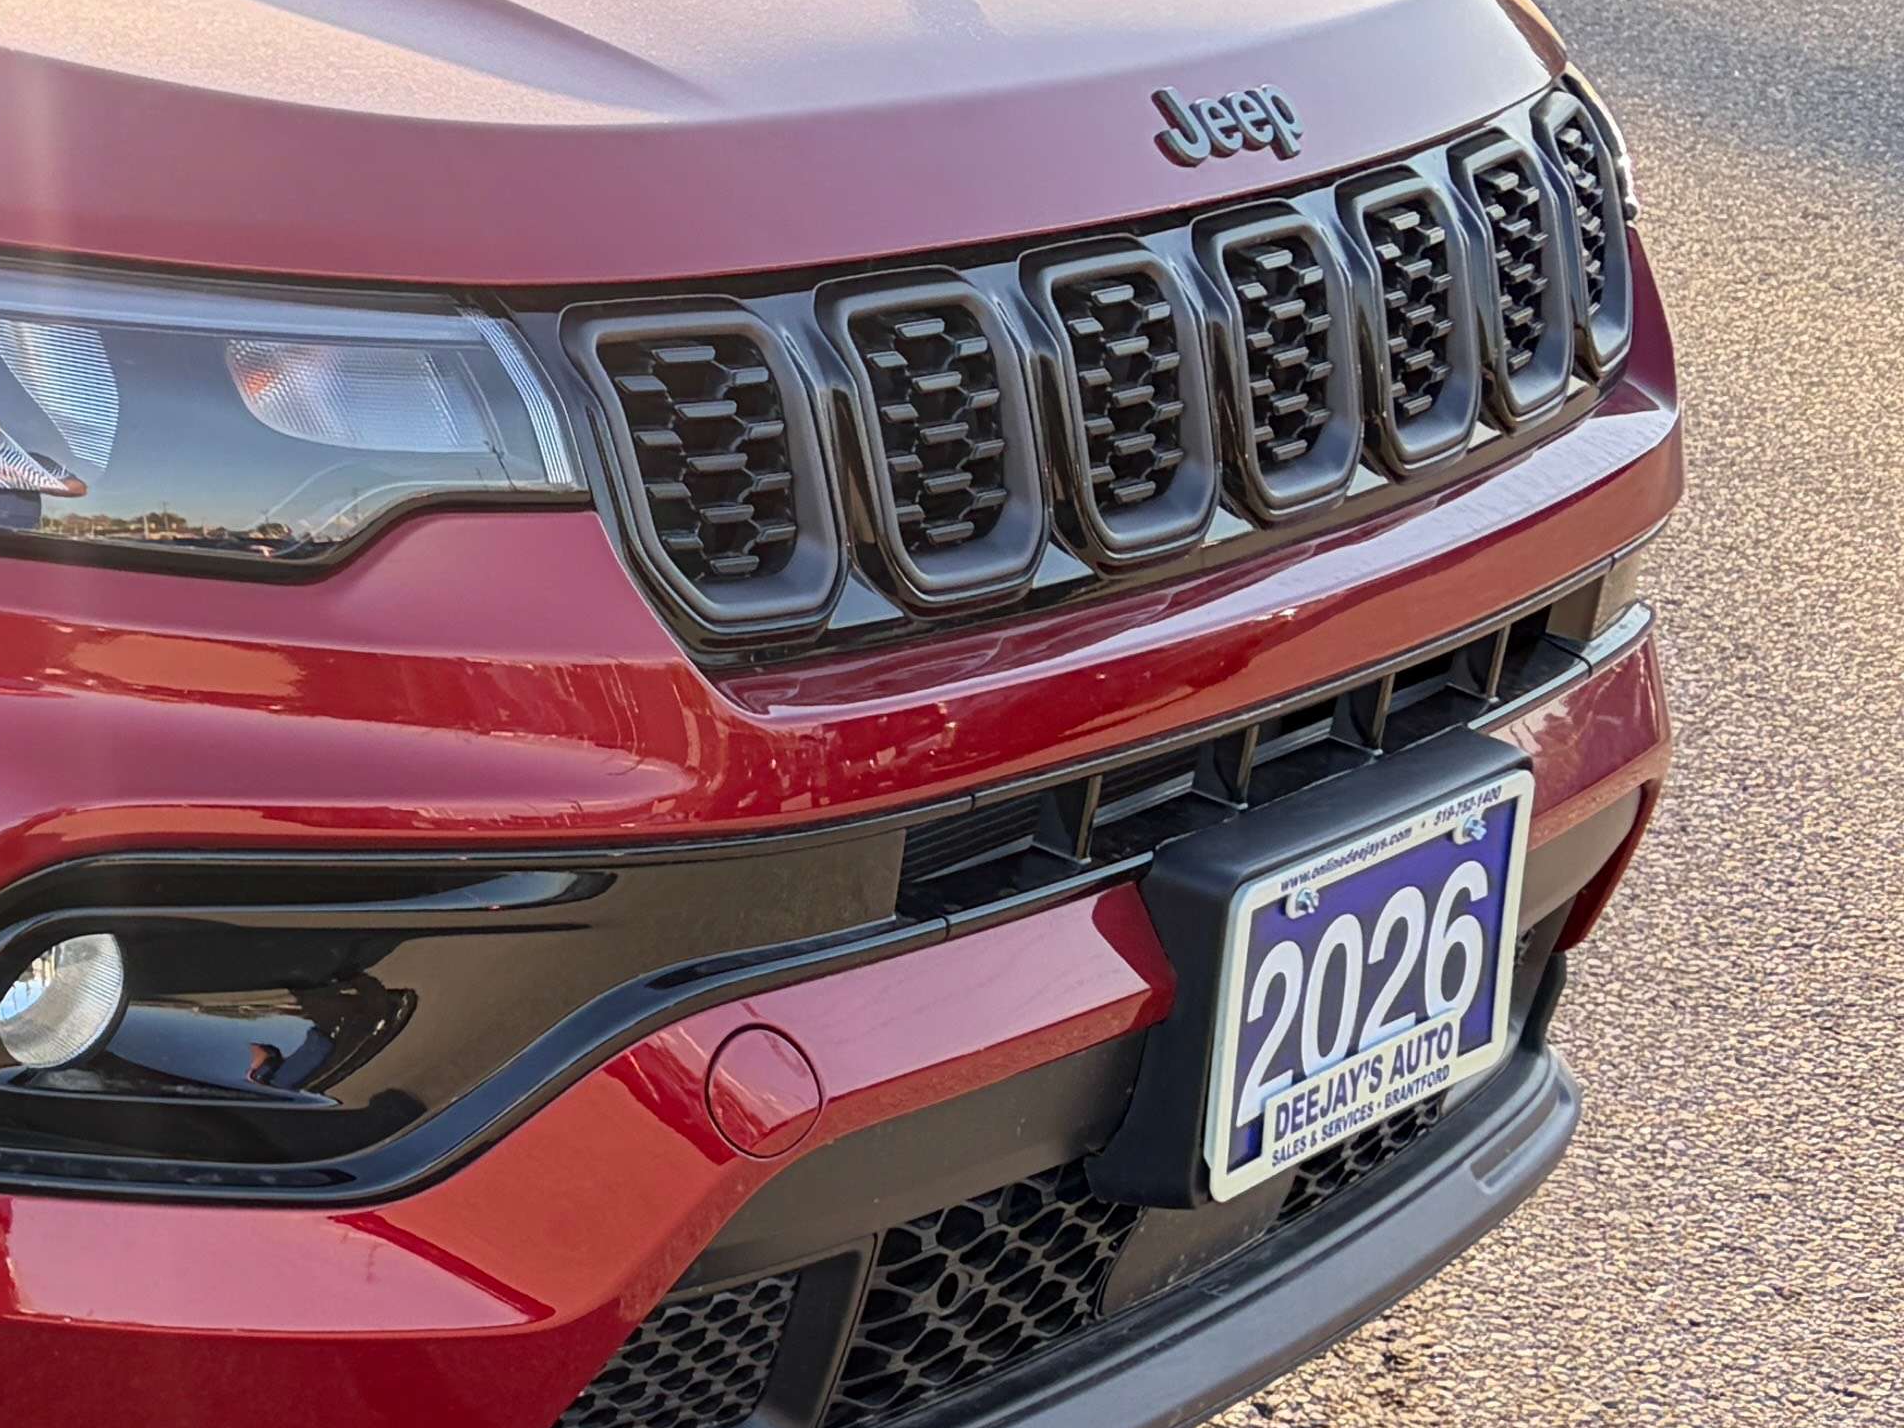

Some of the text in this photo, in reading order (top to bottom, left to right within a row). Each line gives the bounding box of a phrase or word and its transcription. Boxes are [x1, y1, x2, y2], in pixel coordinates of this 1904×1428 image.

[1151, 83, 1304, 168] Jeep
[1236, 860, 1489, 1128] 2026
[1271, 1134, 1308, 1167] SALES
[1321, 1101, 1375, 1142] SERVICES
[1384, 1064, 1451, 1110] BRANTFORD
[1274, 1021, 1454, 1144] DEEJAY'S AUTO
